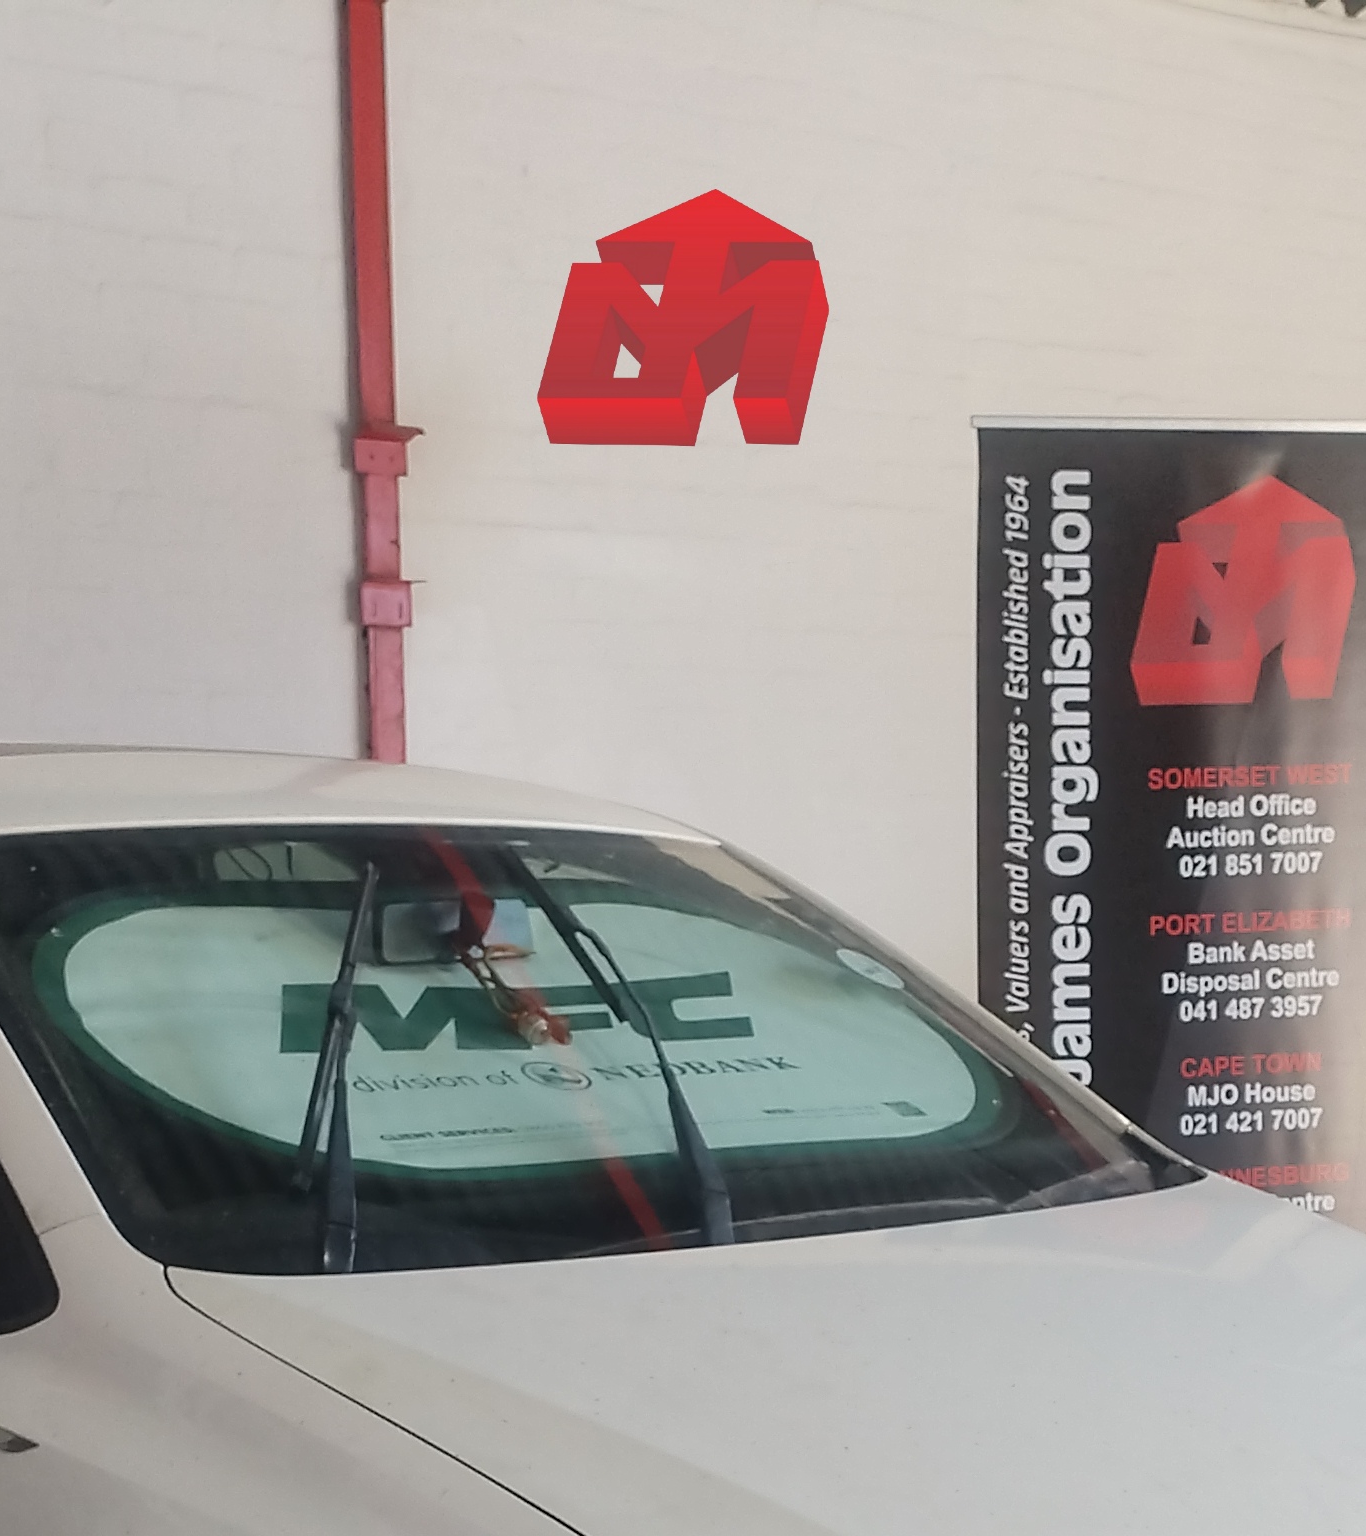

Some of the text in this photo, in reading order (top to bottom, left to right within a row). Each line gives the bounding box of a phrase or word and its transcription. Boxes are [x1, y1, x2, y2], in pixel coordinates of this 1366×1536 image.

[1004, 476, 1030, 541] 1964
[1002, 548, 1030, 700] Established
[1042, 469, 1100, 876] Organisation
[1001, 722, 1034, 859] Appraisers
[1148, 763, 1352, 791] SOMERSET WEST
[1186, 794, 1316, 819] Head Office
[1166, 823, 1335, 849] Auction Centre
[1179, 851, 1323, 878] 021 851 7007
[1004, 860, 1030, 915] and
[1150, 908, 1350, 936] PORT ELIZABETH
[1188, 940, 1315, 966] Bank Asset
[1003, 923, 1030, 1012] Valuers
[1161, 967, 1340, 996] Disposal Centre
[1179, 995, 1323, 1023] 041 487 3957
[1180, 1052, 1322, 1079] CAPE TOWN
[353, 1072, 479, 1092] division
[486, 1070, 519, 1085] of
[1188, 1083, 1316, 1108] MJO House
[1180, 1108, 1323, 1136] 021 421 7007
